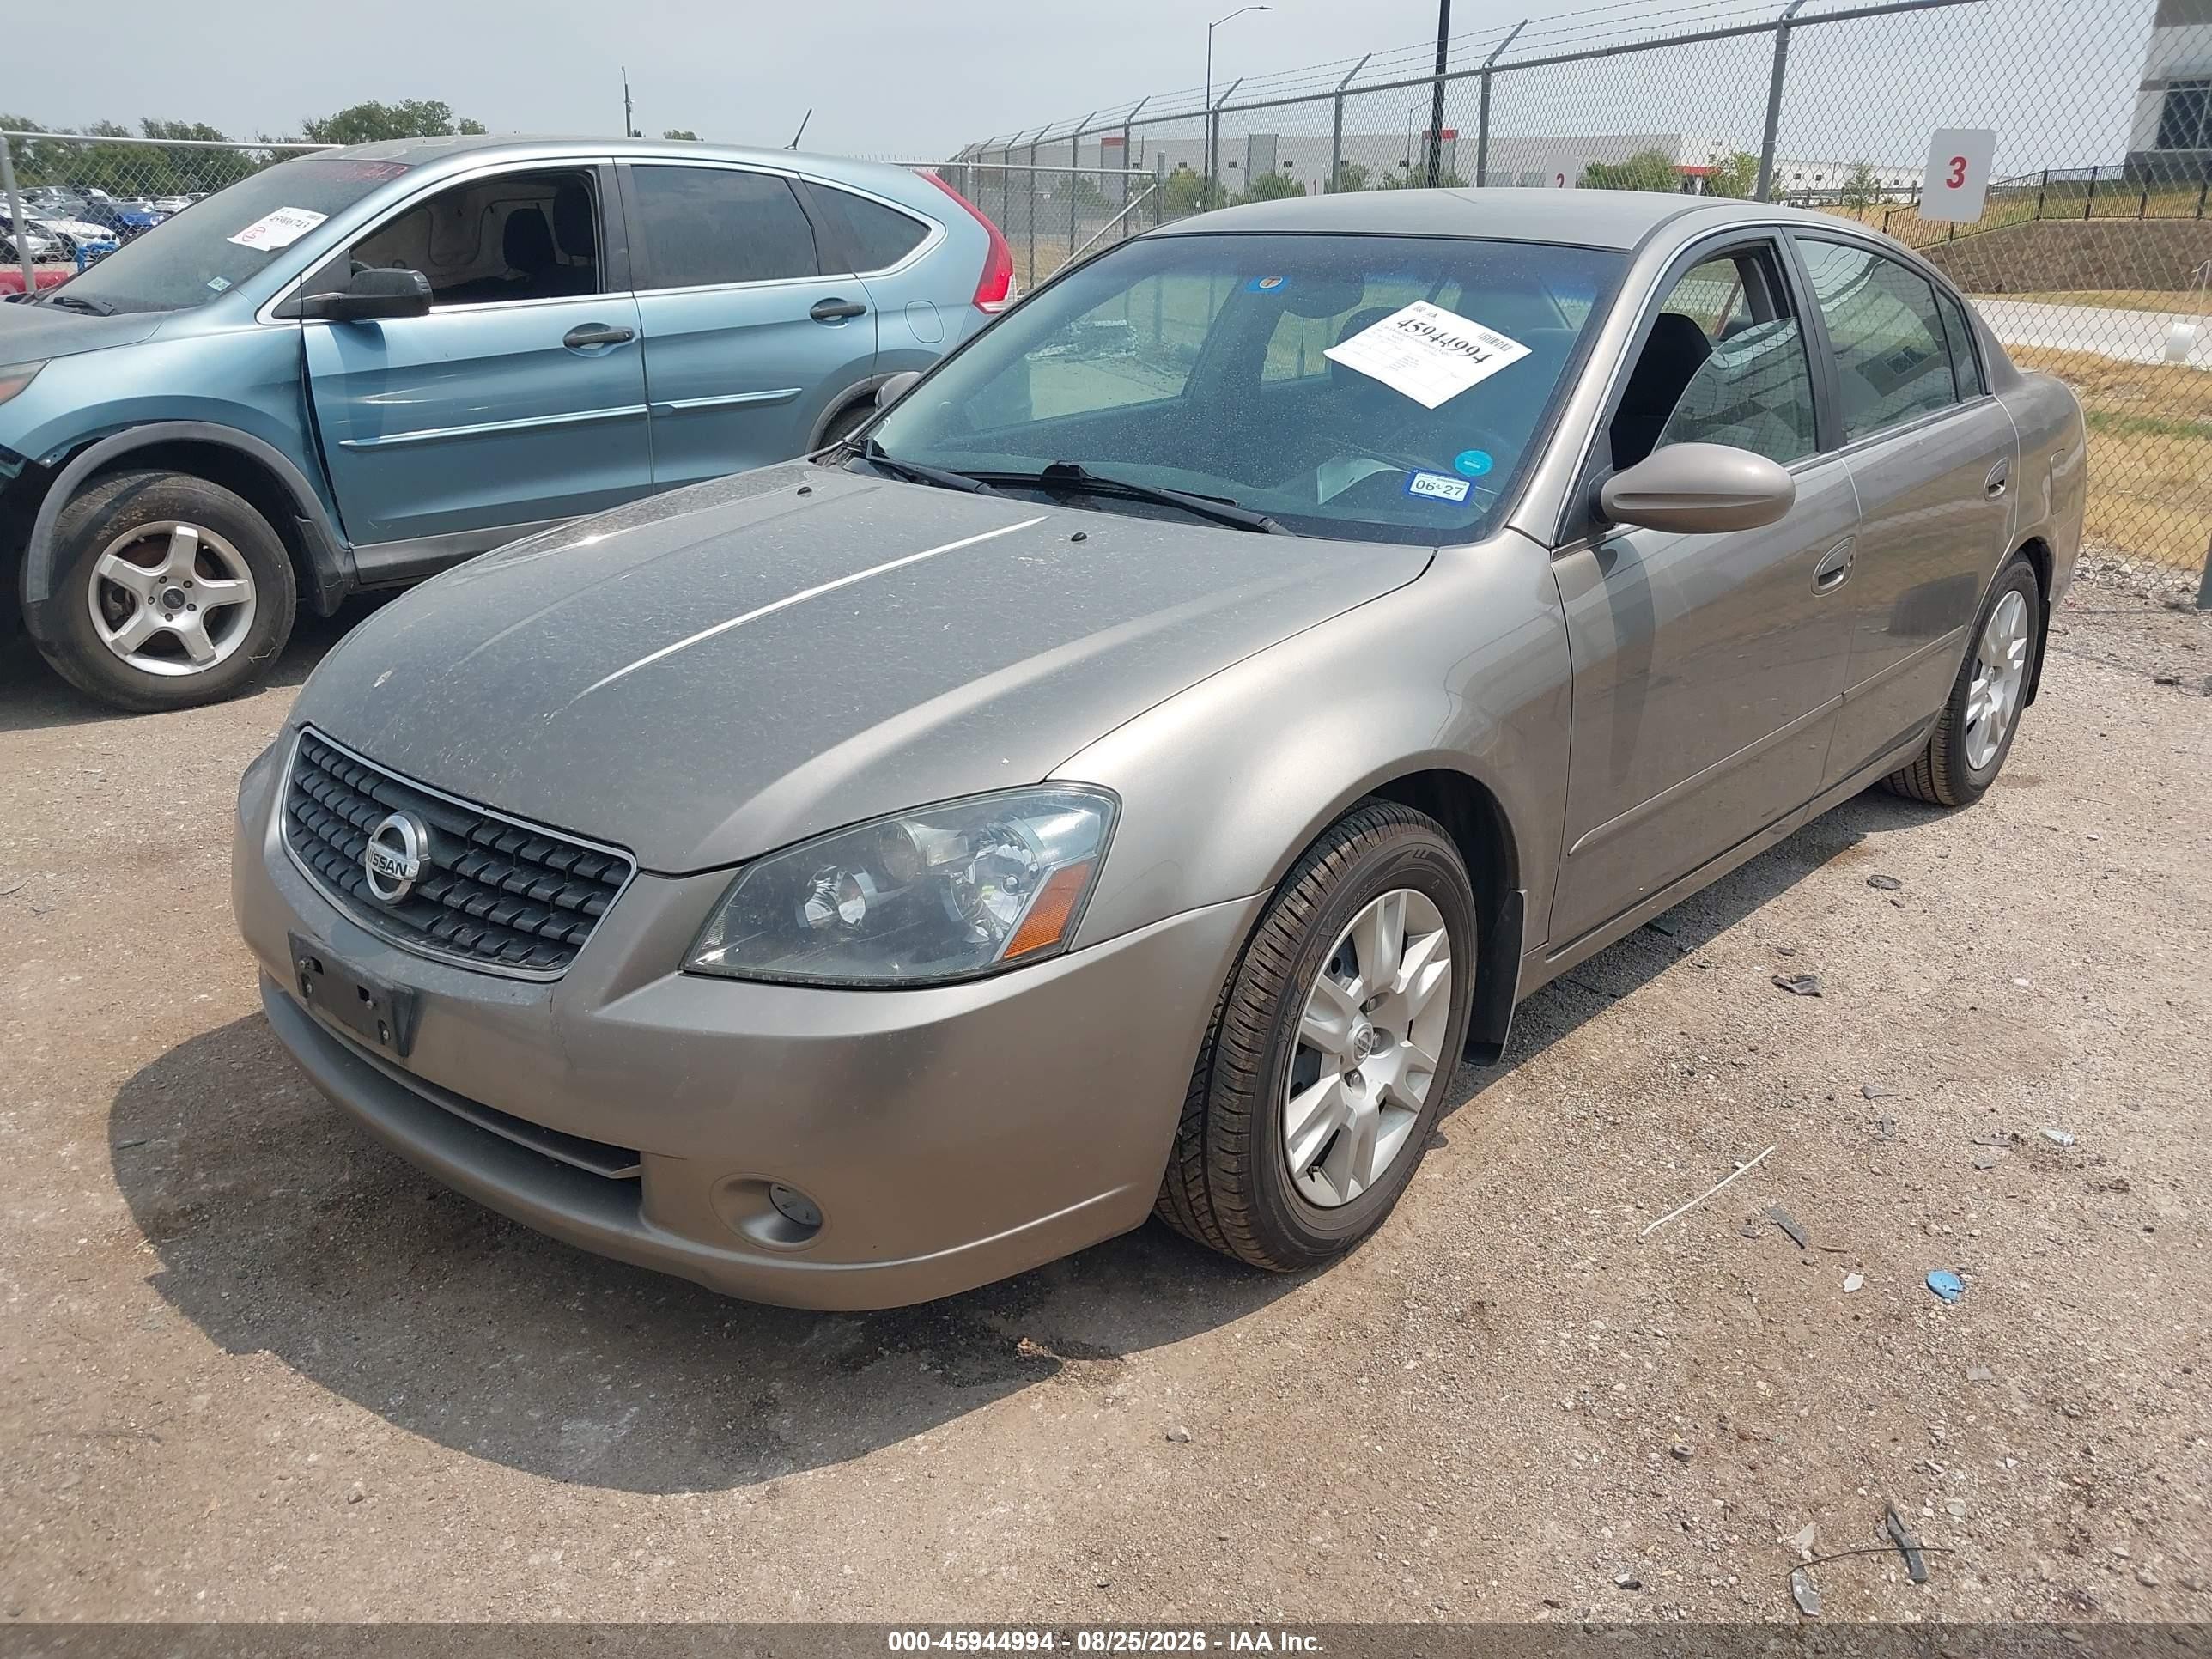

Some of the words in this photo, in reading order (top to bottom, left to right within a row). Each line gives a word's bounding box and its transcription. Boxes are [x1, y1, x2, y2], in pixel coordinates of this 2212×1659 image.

[1313, 179, 1317, 196] 1
[1946, 156, 1966, 189] 3
[1396, 318, 1492, 364] 45944994
[1415, 480, 1436, 491] 06
[1443, 485, 1464, 496] 27
[368, 845, 407, 876] NISSAN
